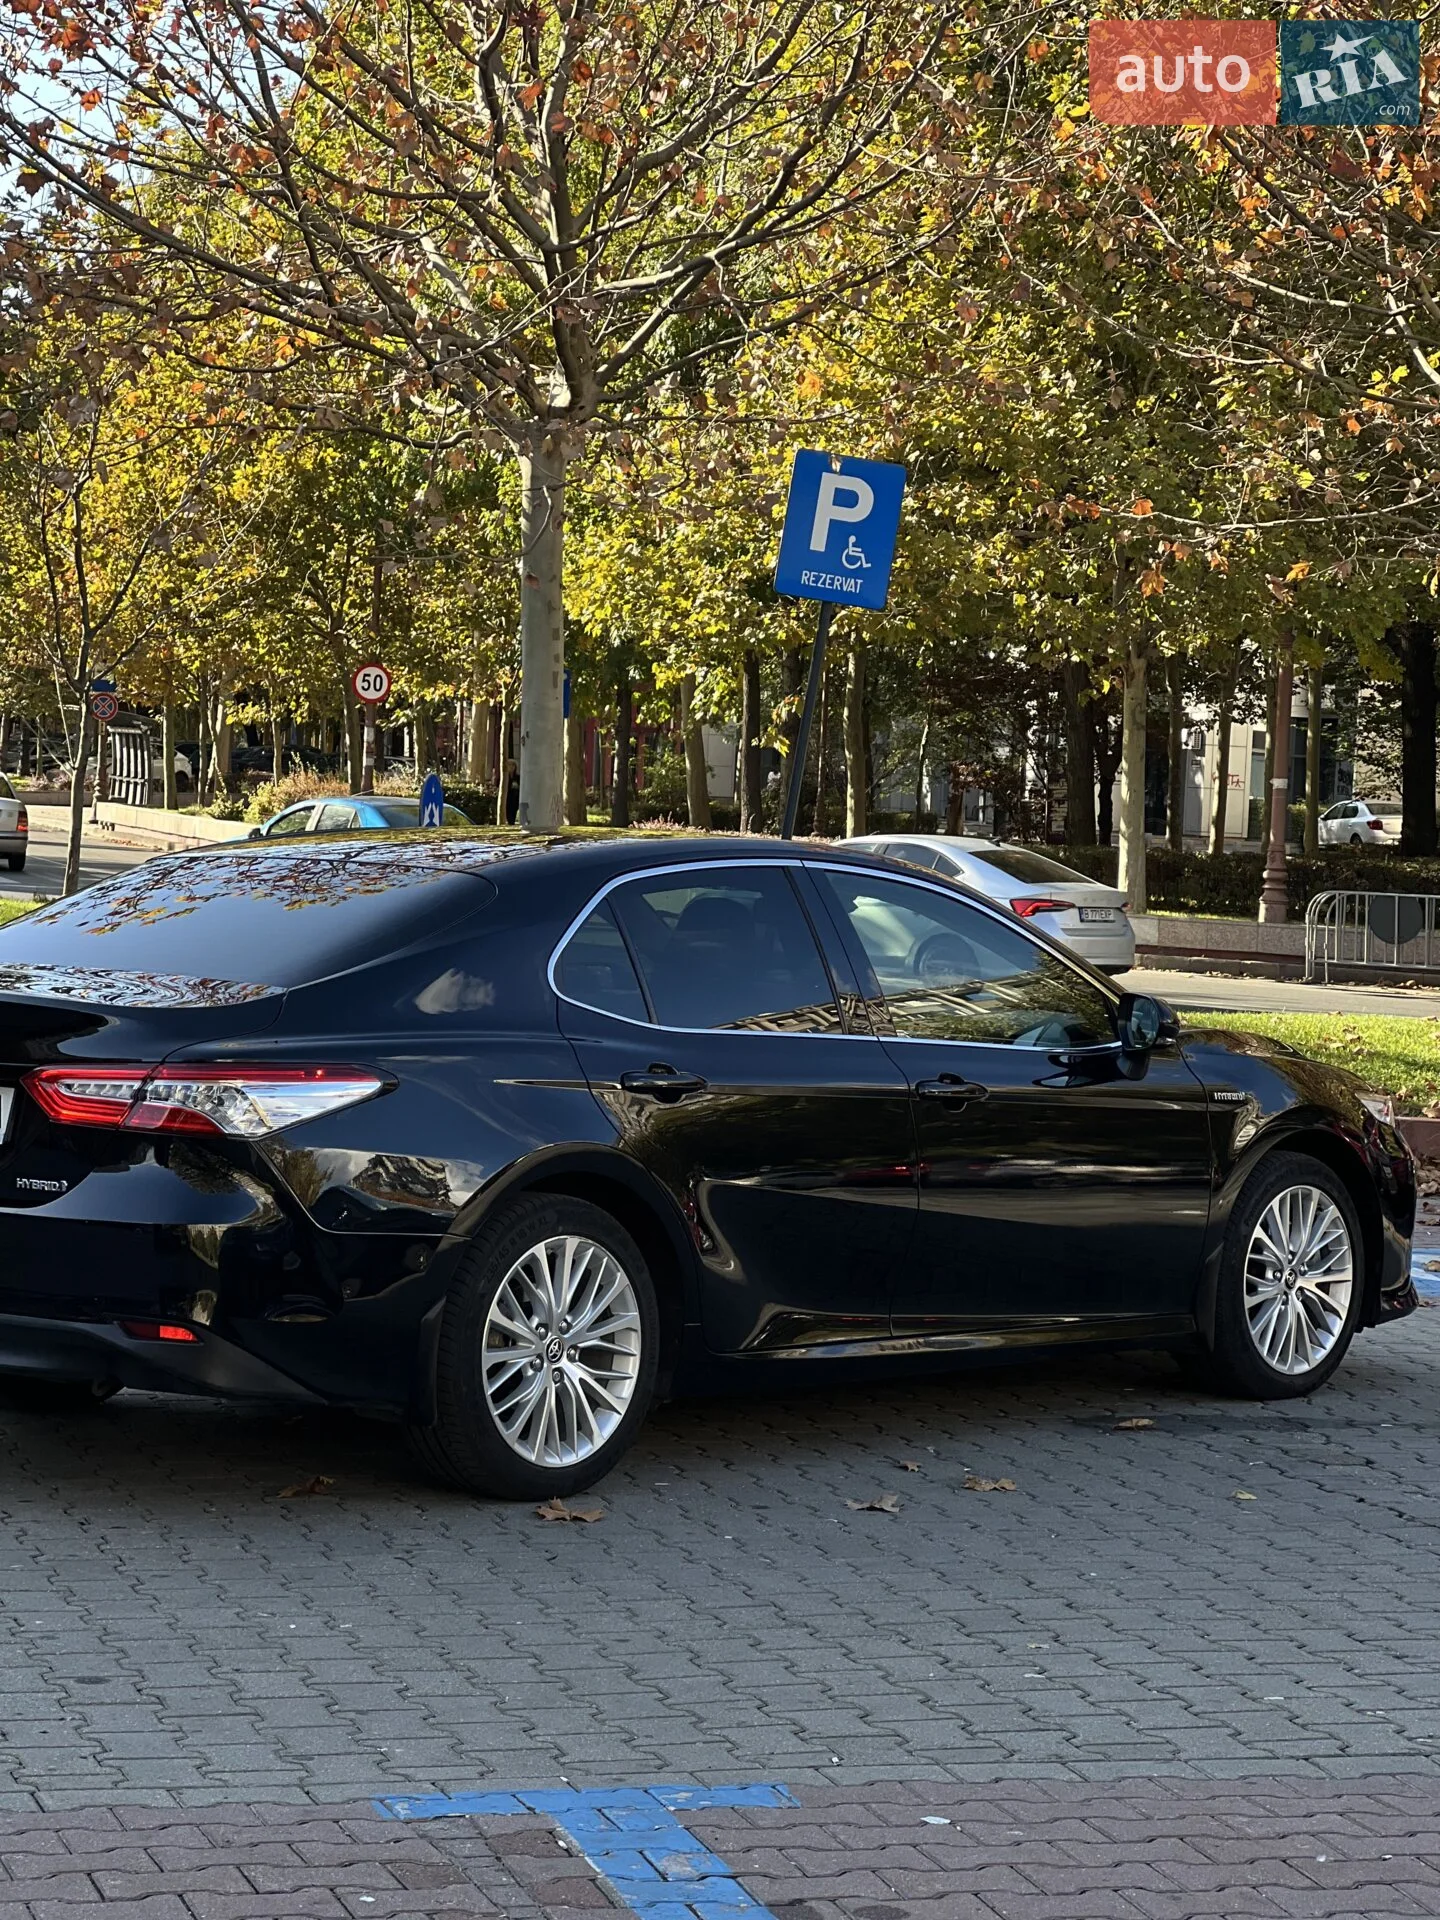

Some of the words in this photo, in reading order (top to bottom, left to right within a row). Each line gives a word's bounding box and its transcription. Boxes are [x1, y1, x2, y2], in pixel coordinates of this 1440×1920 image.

[809, 471, 875, 552] P
[801, 570, 863, 594] REZERVAT
[361, 673, 384, 692] 50
[16, 1178, 59, 1191] HYBRID
